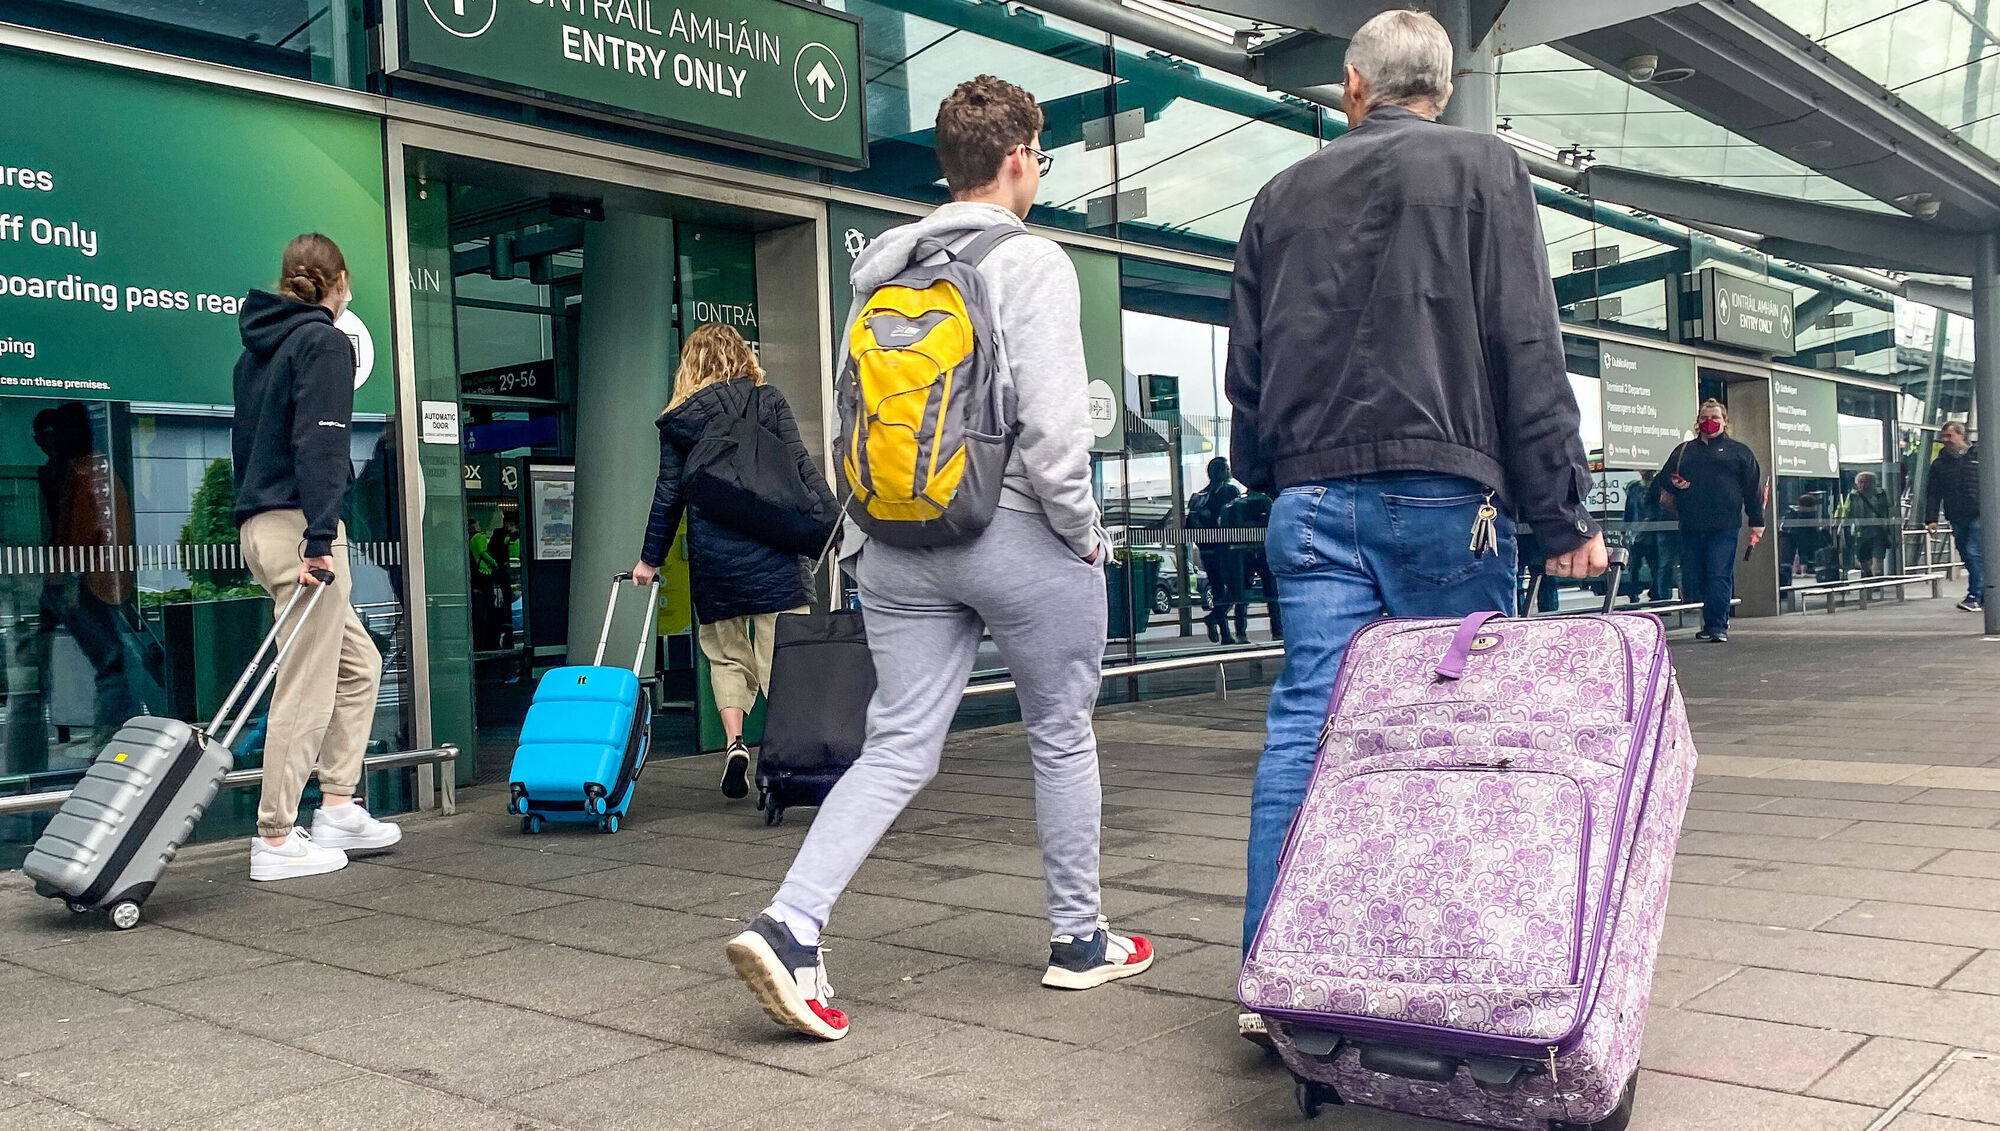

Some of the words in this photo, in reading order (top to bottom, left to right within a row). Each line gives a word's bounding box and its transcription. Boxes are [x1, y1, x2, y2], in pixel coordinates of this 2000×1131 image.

[669, 8, 781, 66] AMHÁIN
[562, 24, 667, 80] ENTRY
[673, 53, 747, 99] ONLY
[0, 213, 24, 242] ff
[31, 217, 99, 257] Only
[125, 286, 190, 312] pass
[692, 300, 757, 328] IONTRÁ
[1739, 312, 1759, 331] ENTRY
[1758, 317, 1773, 334] ONLY
[20, 377, 34, 386] on
[35, 377, 64, 388] these
[64, 379, 111, 390] premises.
[499, 369, 537, 391] 29-56
[1624, 383, 1629, 394] 2
[424, 412, 456, 421] AUTOMATIC
